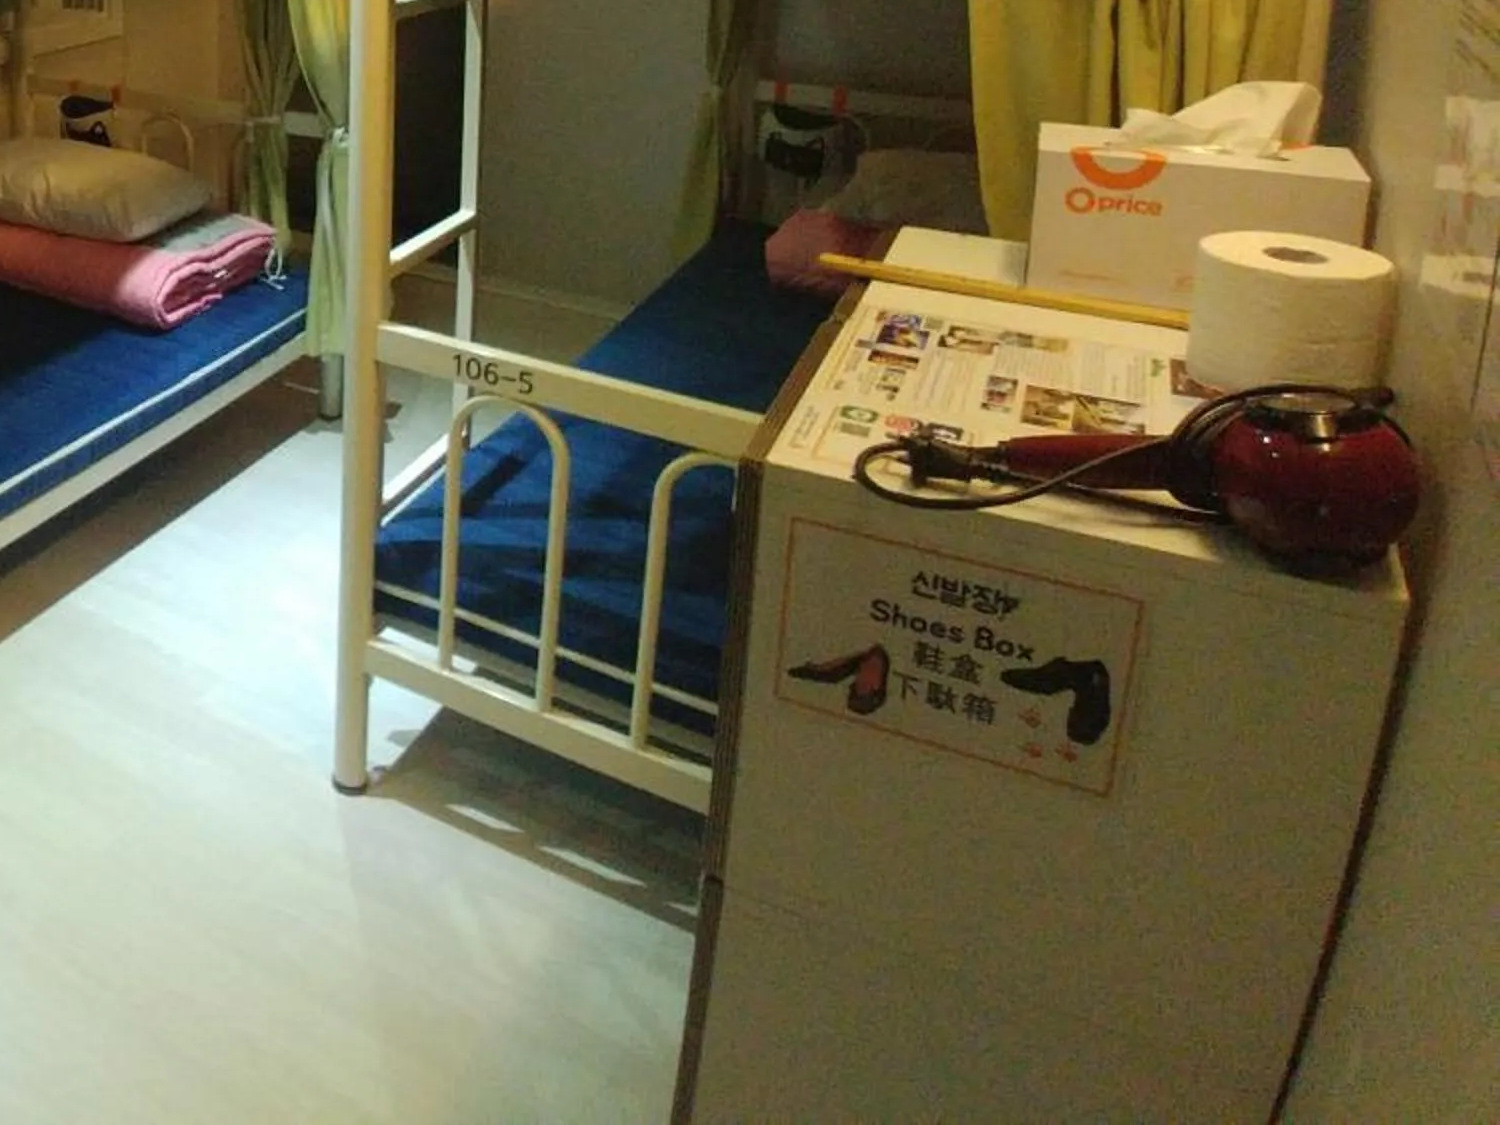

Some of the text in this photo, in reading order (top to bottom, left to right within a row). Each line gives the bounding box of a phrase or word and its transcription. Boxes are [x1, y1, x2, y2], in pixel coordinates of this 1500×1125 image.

[452, 354, 534, 394] 106-5
[912, 571, 1010, 617] 신발장
[869, 598, 1035, 661] Shoes Box
